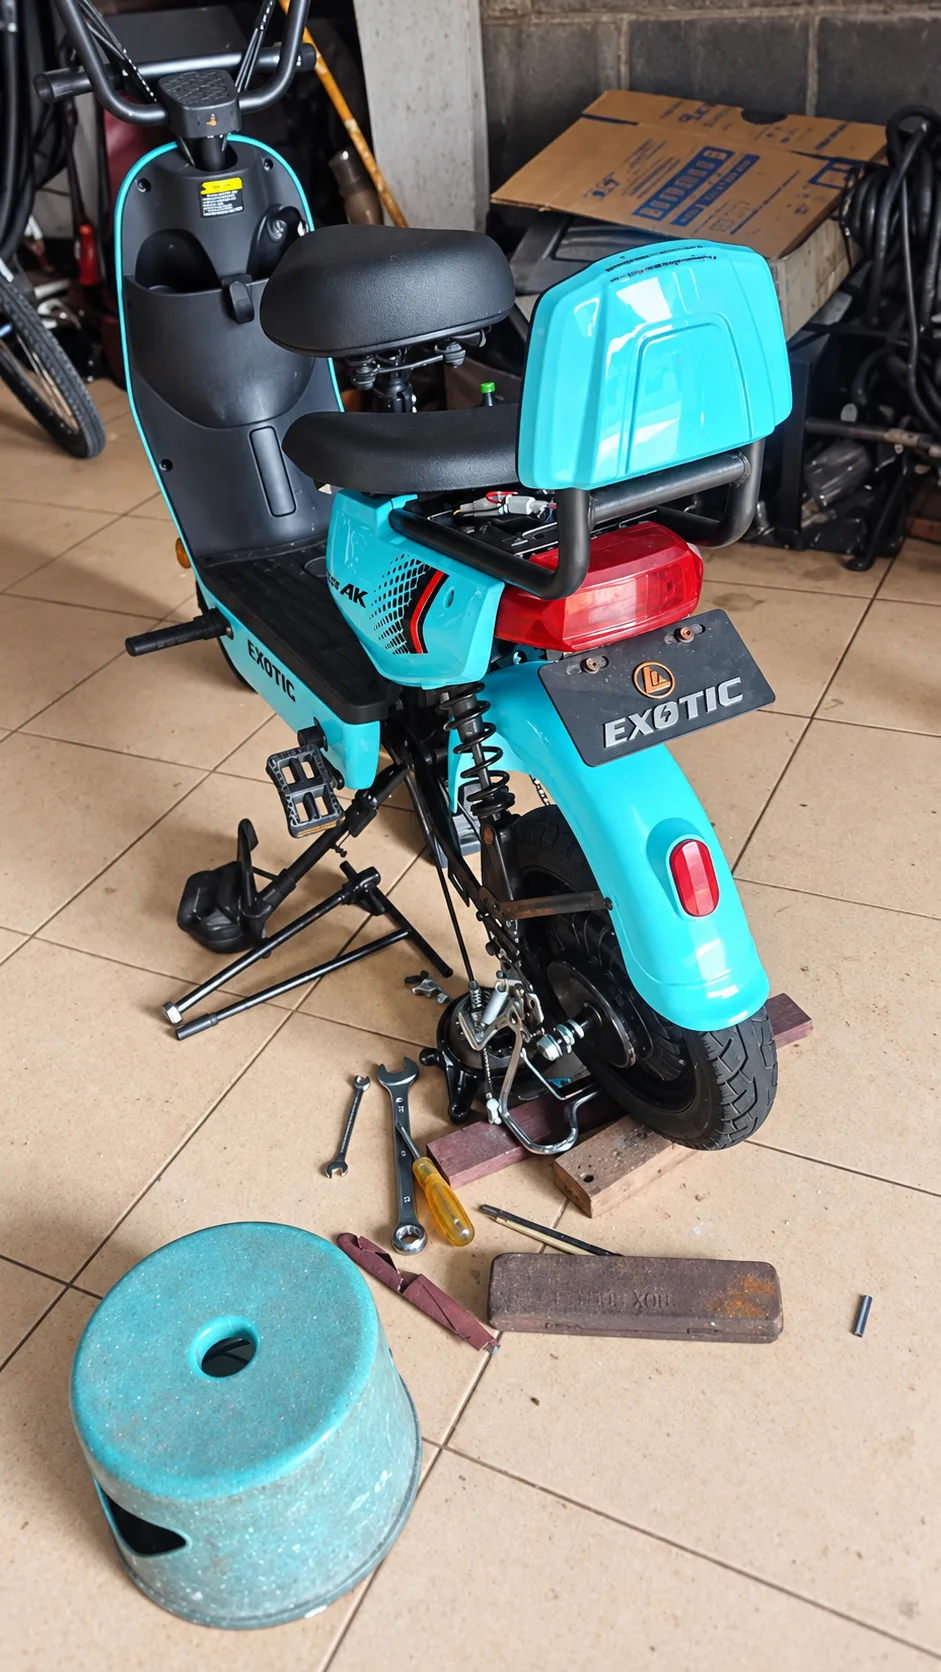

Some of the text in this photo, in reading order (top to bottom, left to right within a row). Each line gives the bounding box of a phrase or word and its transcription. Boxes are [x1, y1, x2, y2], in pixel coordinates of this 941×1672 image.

[340, 583, 369, 609] AK
[247, 639, 296, 703] EXOTIC
[604, 676, 744, 748] EXOTIC
